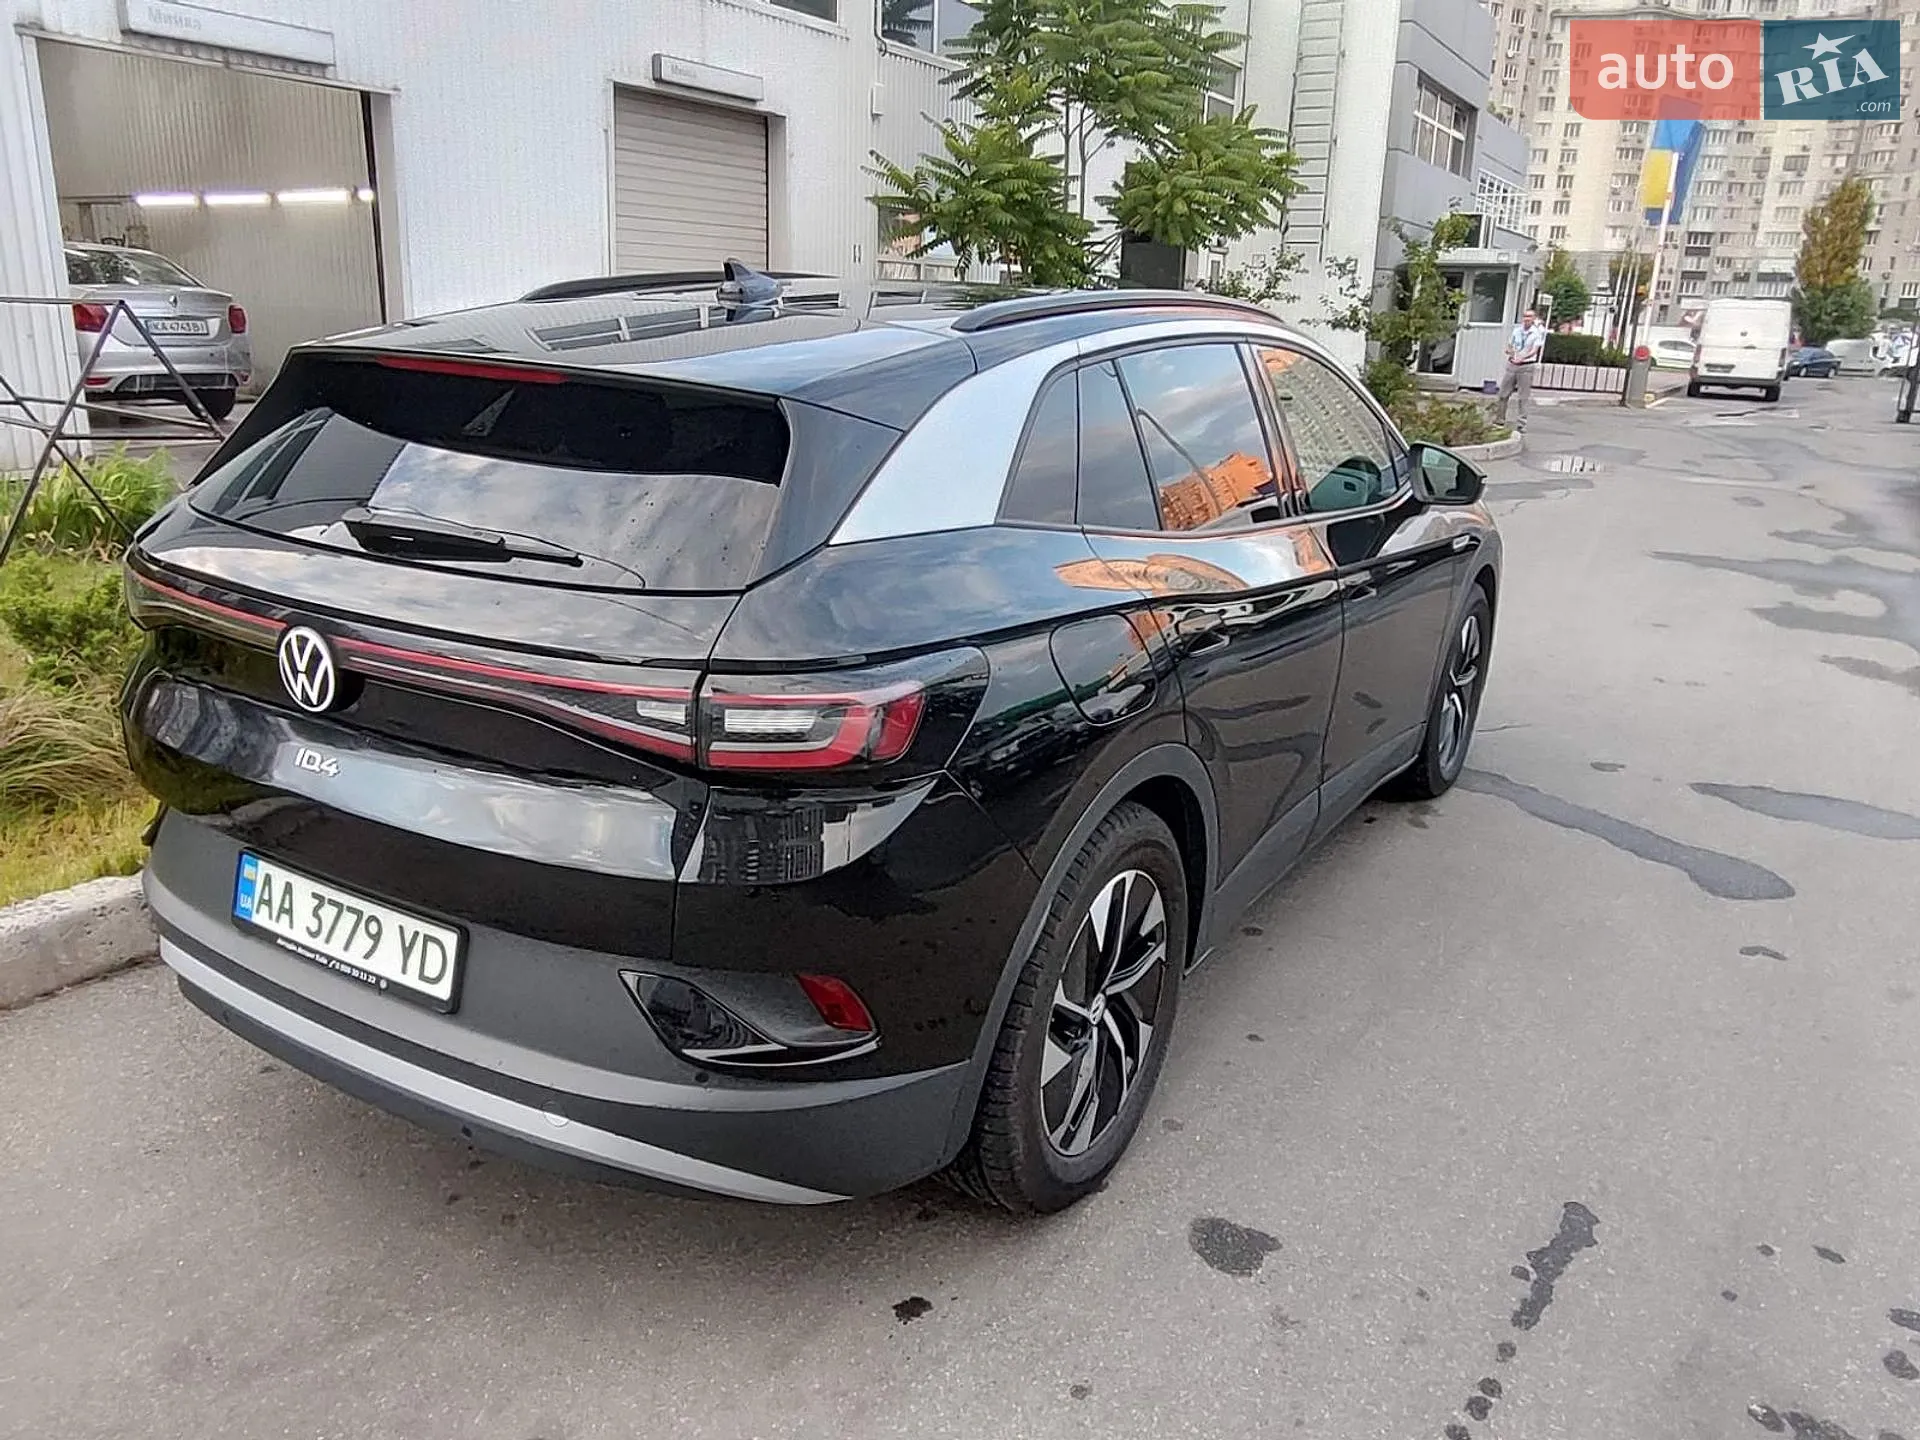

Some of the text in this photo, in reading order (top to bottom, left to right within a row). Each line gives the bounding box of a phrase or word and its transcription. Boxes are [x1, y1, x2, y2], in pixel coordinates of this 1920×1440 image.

[255, 872, 294, 930] AA
[306, 891, 383, 960] 3779
[398, 923, 448, 986] YD
